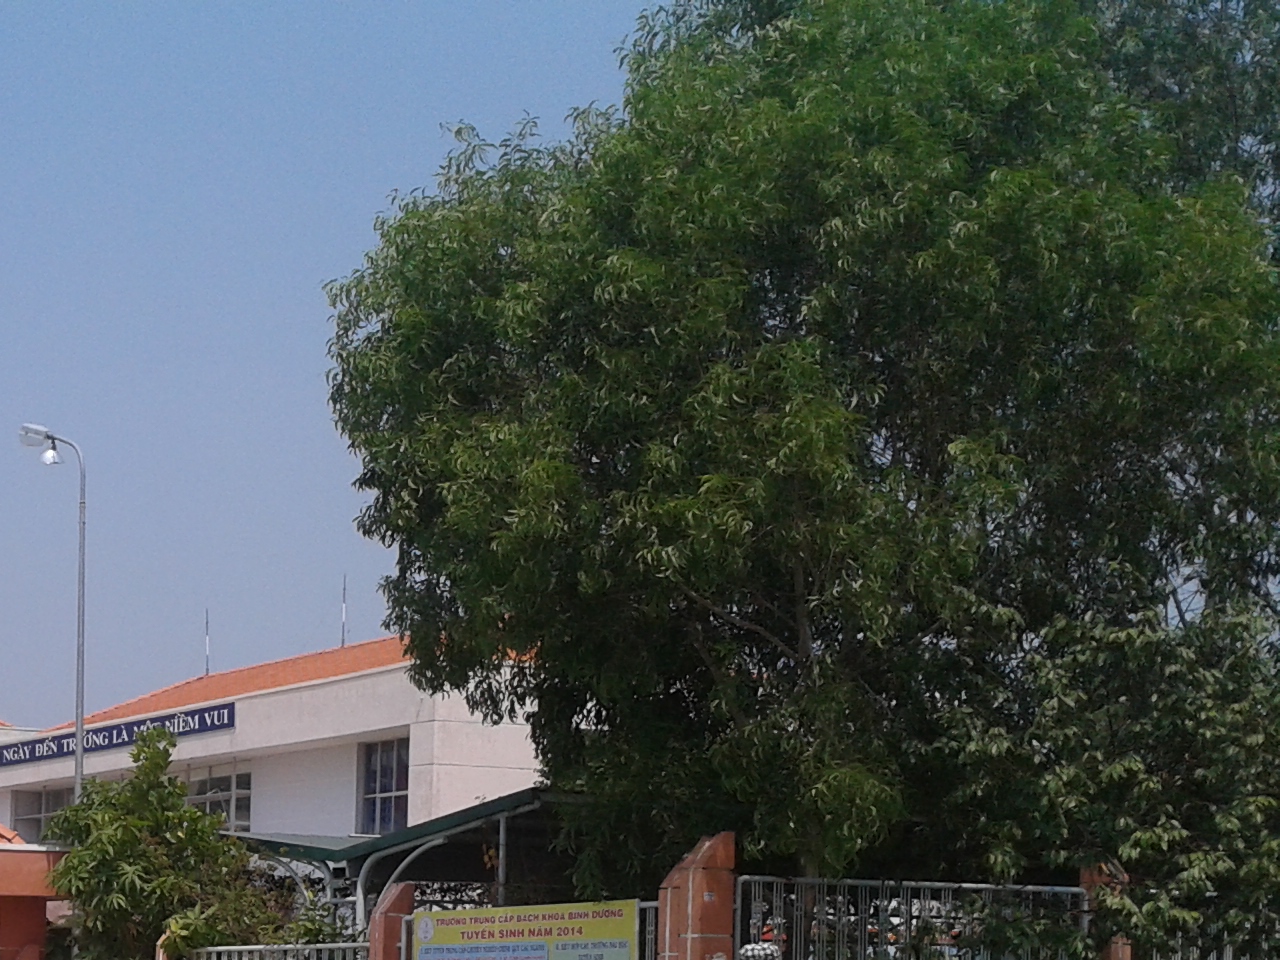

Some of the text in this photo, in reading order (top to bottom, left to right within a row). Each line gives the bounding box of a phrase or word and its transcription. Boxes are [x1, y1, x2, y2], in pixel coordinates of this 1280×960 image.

[3, 744, 32, 762] NGÀY
[35, 737, 58, 757] ĐẾN
[61, 731, 108, 752] TRỜNG
[112, 726, 129, 744] LÀ
[204, 709, 229, 727] VUI
[469, 916, 496, 925] TRUNG
[541, 912, 566, 921] KHOA
[498, 928, 524, 939] SINH
[528, 926, 553, 938] NĂM
[556, 926, 584, 937] 2014
